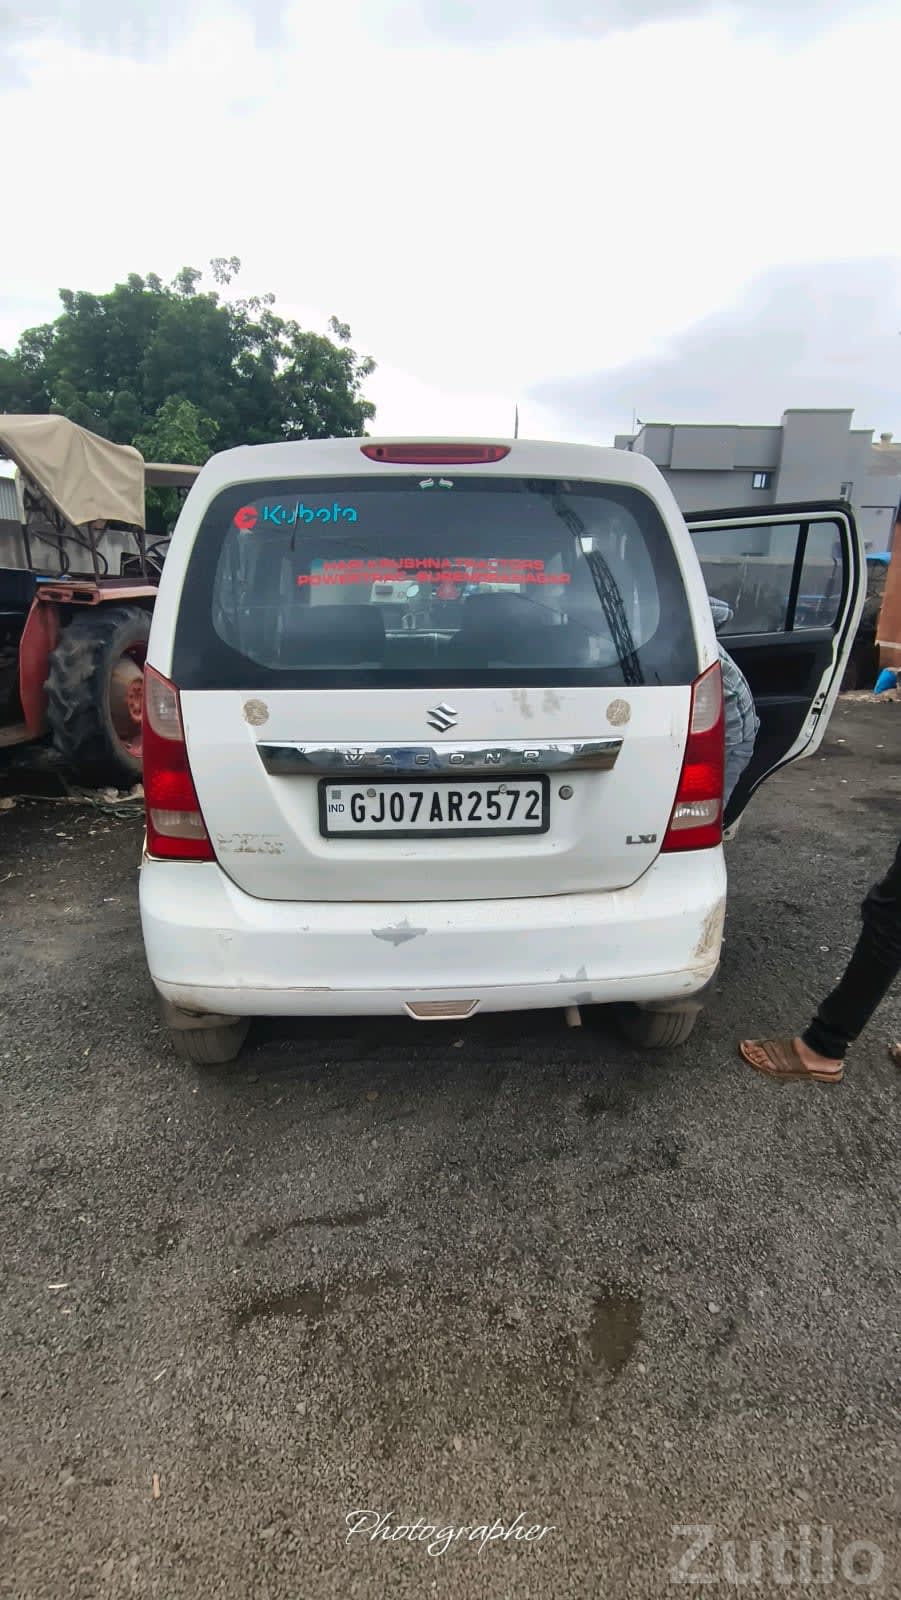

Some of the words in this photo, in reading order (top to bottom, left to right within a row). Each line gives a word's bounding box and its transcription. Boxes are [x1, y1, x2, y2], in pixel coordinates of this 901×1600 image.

[263, 502, 358, 525] Kubota
[328, 804, 345, 813] IND
[351, 789, 540, 823] GJ07AR2572
